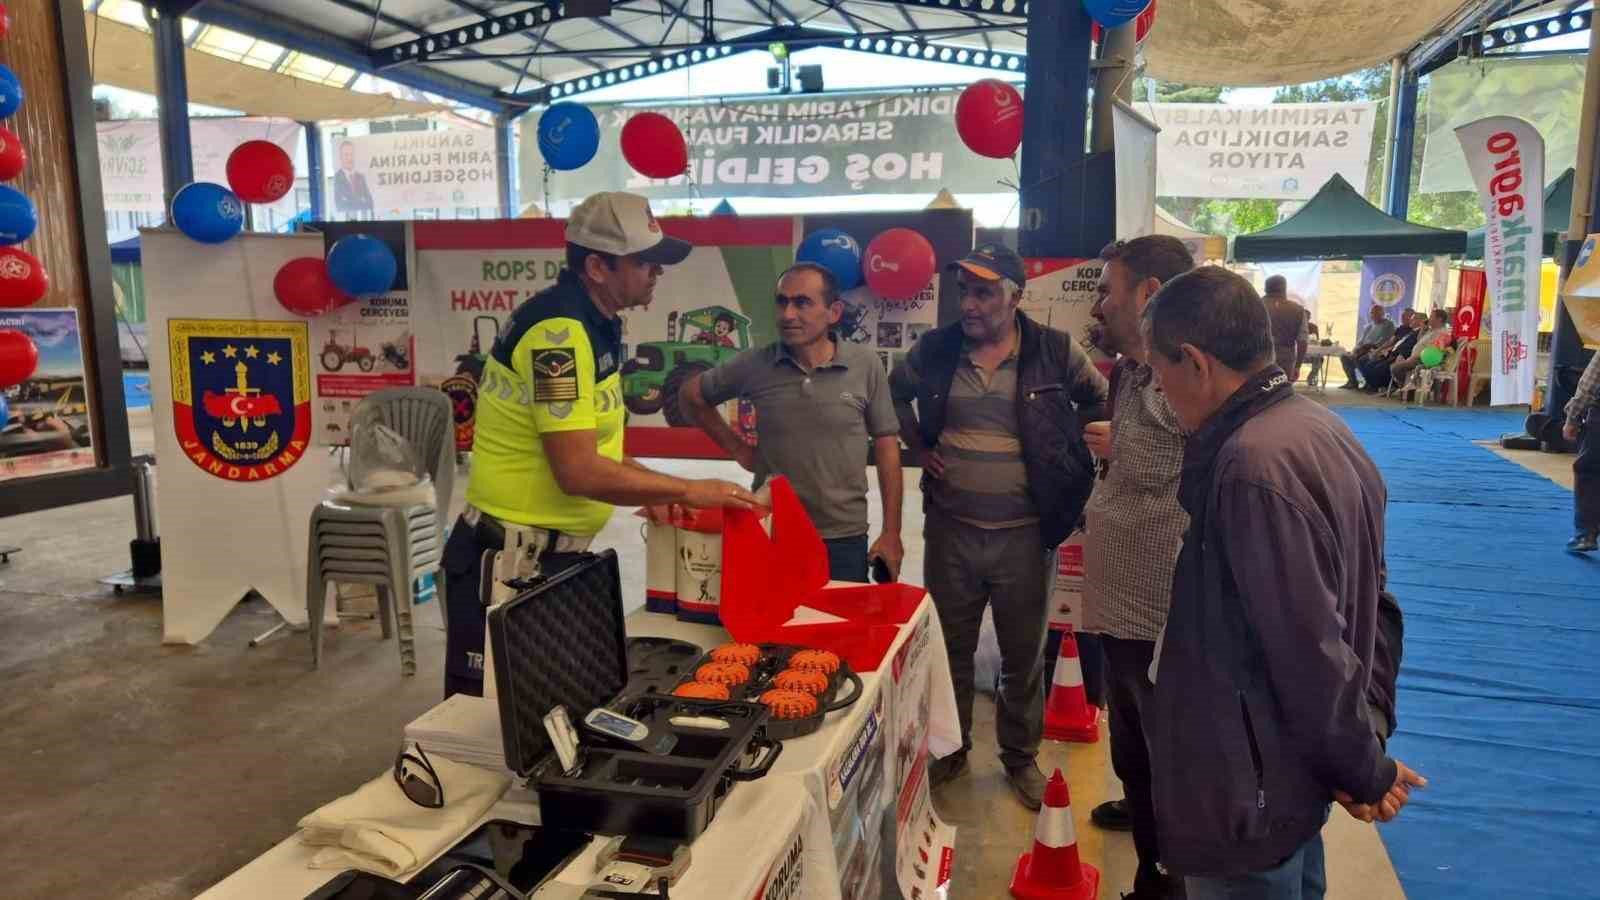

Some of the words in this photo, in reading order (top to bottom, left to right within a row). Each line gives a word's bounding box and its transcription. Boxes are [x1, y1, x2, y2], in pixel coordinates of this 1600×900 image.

[481, 260, 537, 281] ROPS
[450, 288, 518, 312] HAYAT
[184, 438, 304, 480] JANDARMA
